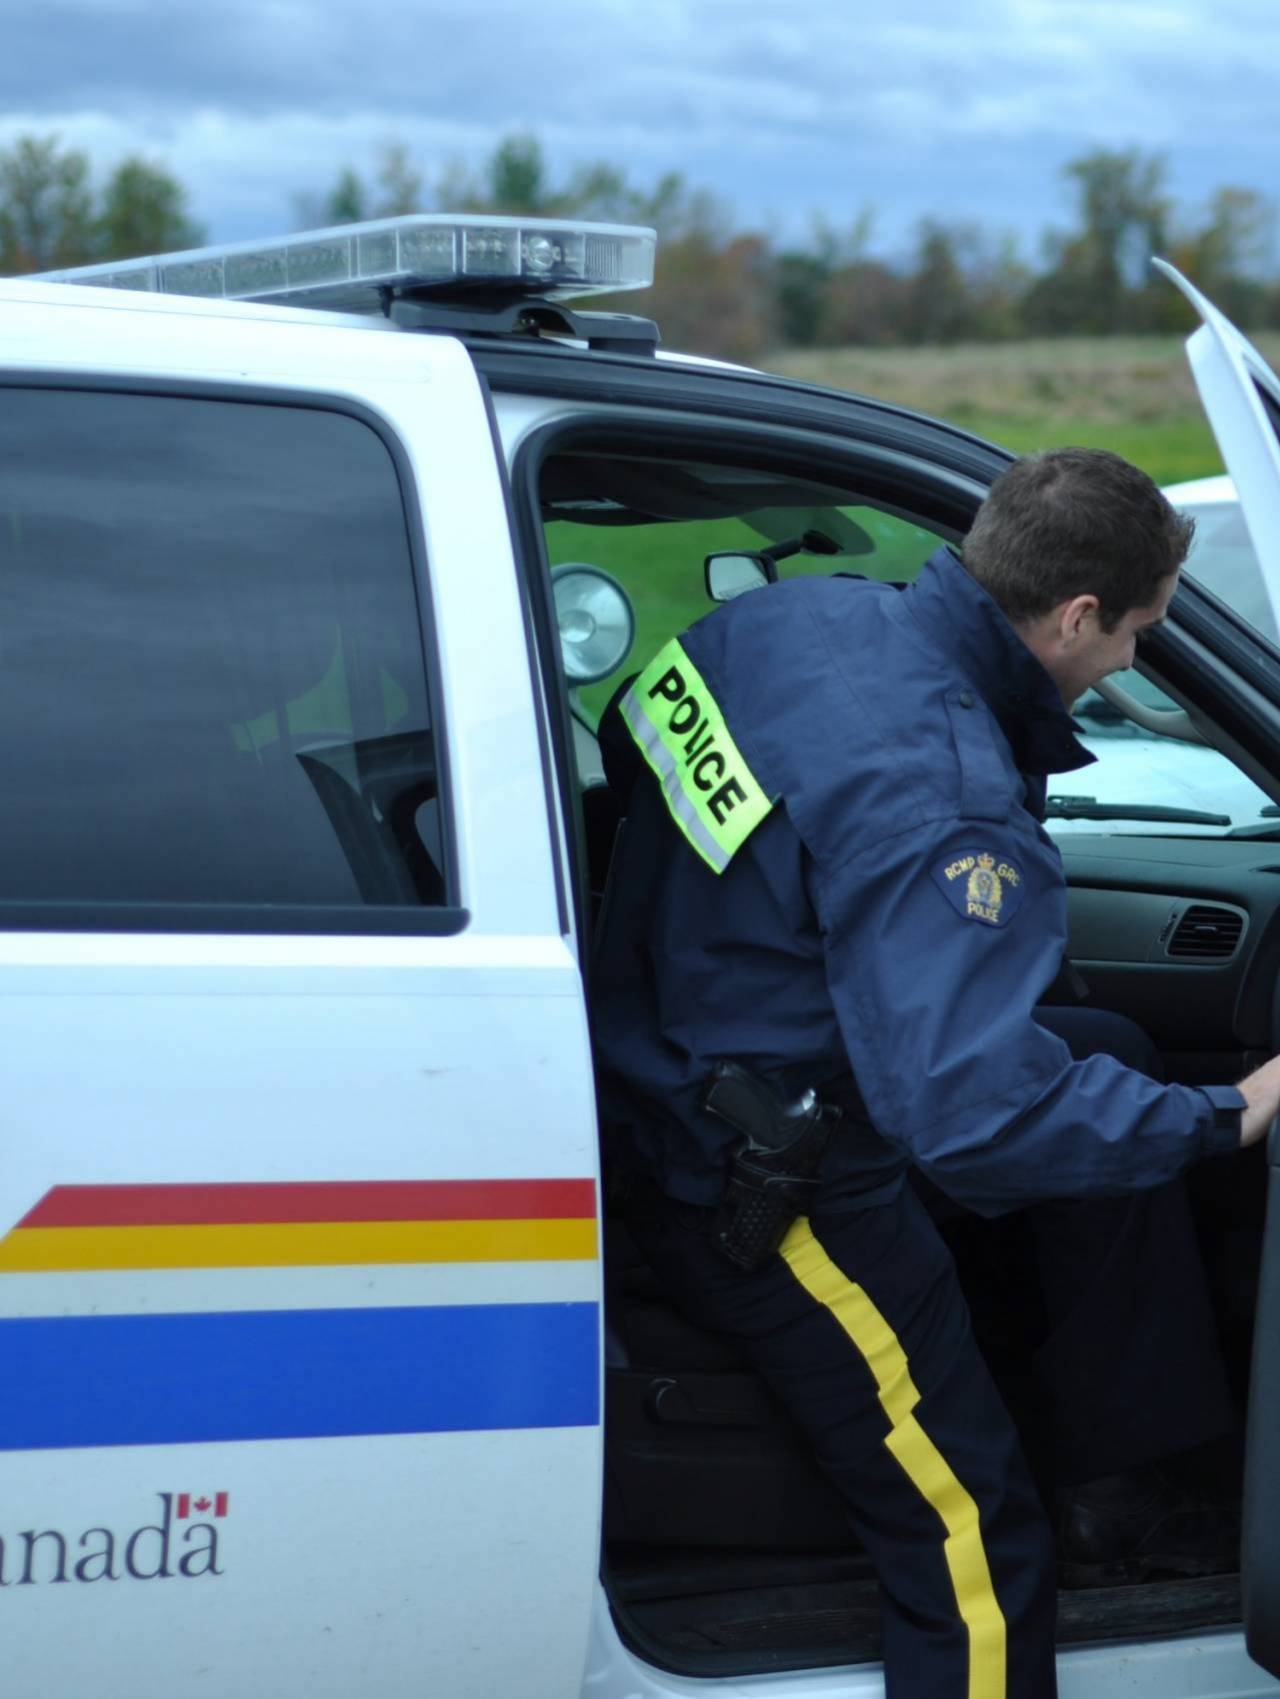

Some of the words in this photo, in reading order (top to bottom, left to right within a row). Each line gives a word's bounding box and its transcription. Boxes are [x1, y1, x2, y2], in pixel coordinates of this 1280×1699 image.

[648, 665, 748, 826] POLICE
[944, 856, 975, 880] RCMP
[998, 864, 1020, 887] GRC
[967, 902, 998, 922] POLICE
